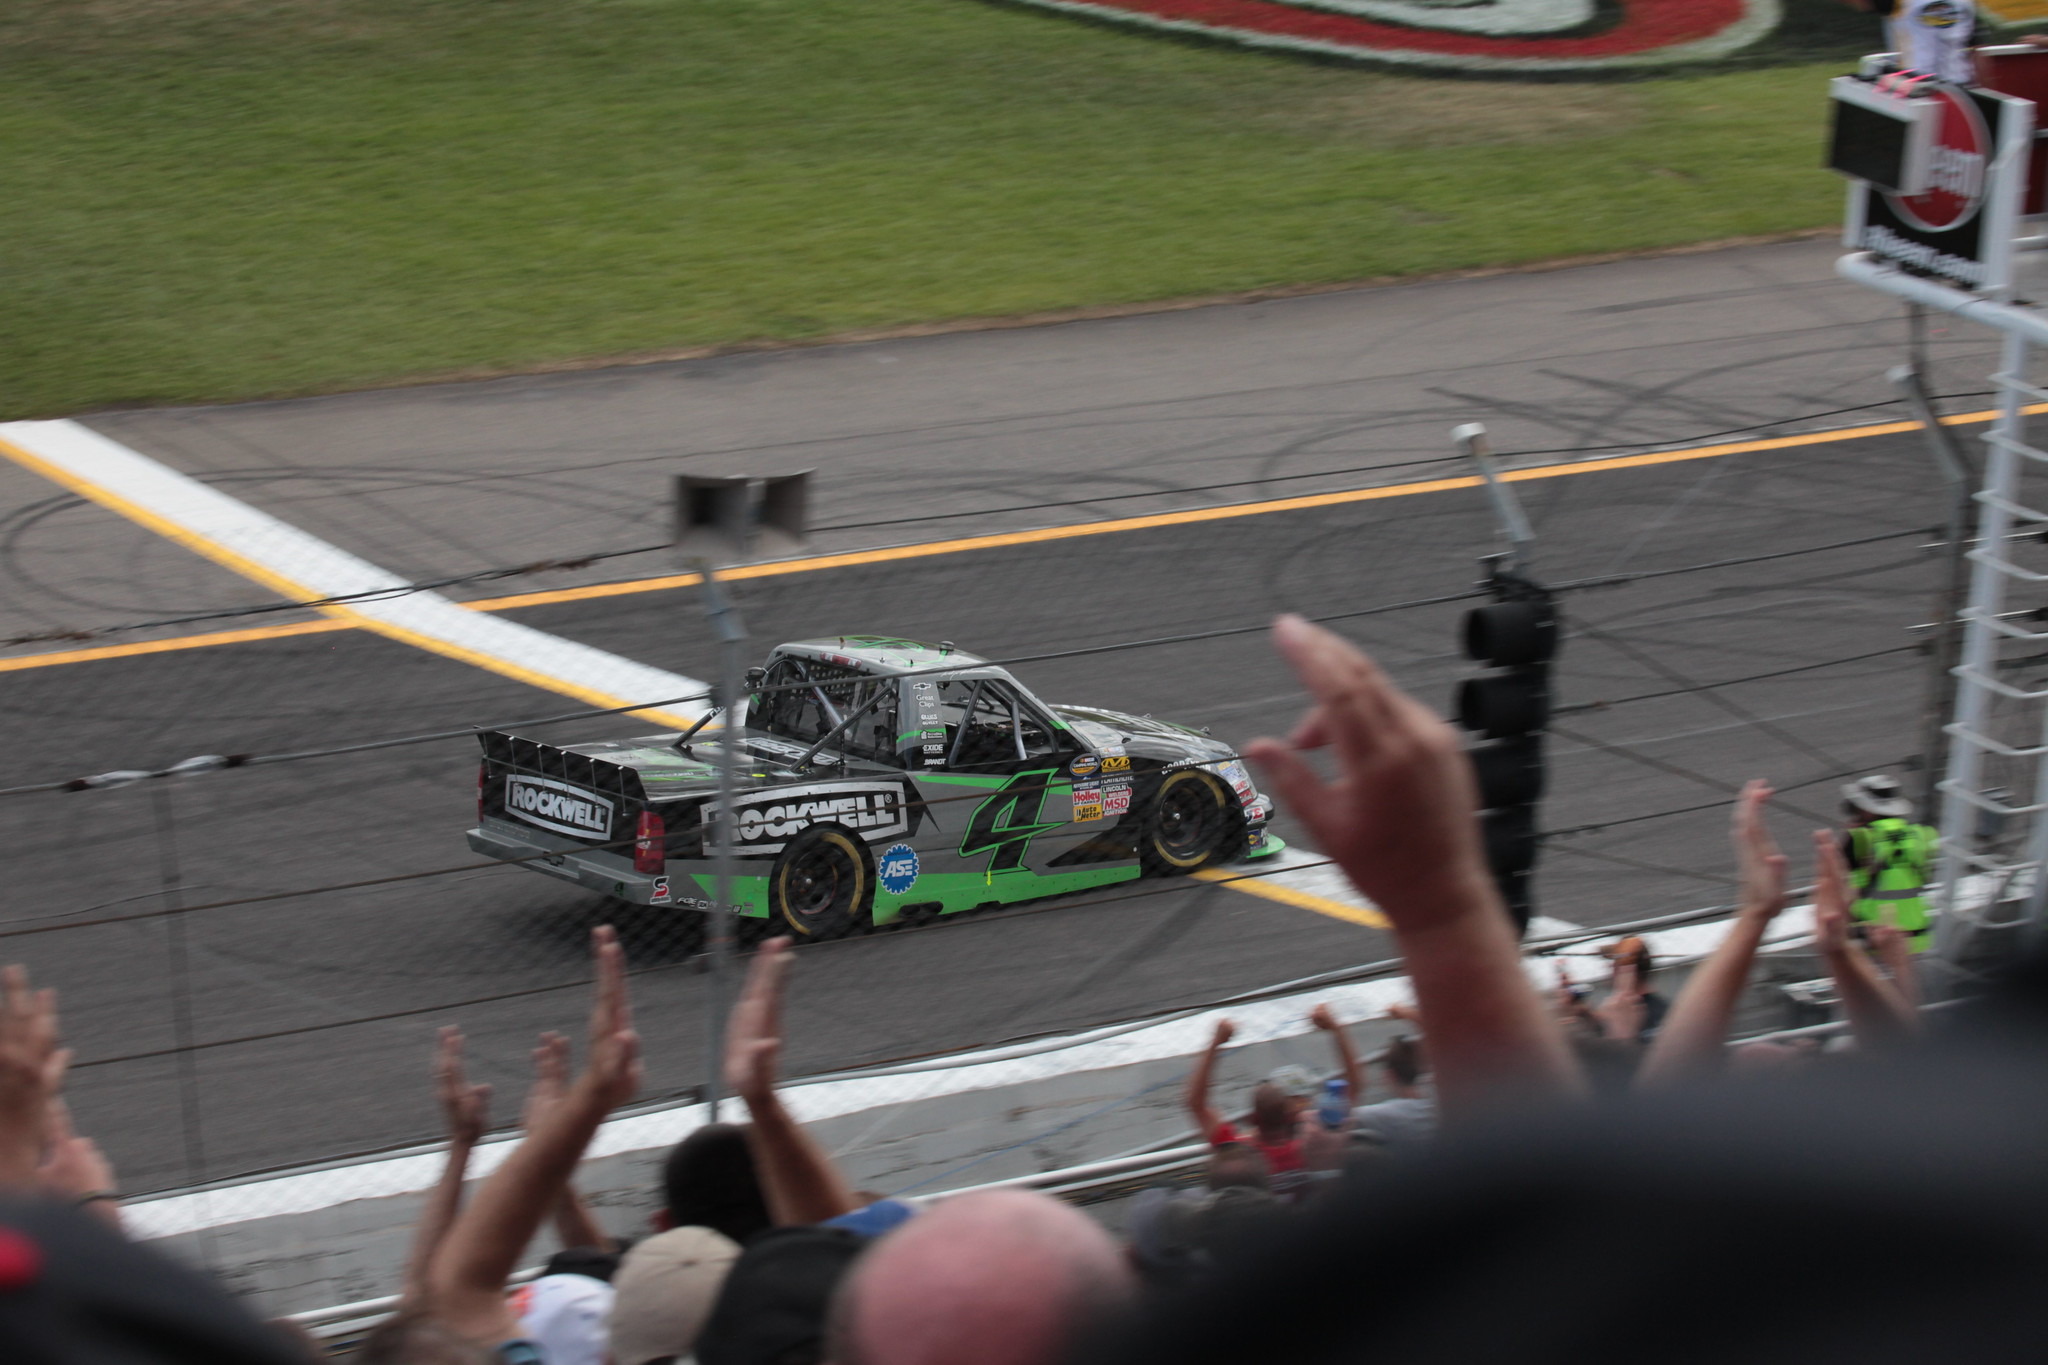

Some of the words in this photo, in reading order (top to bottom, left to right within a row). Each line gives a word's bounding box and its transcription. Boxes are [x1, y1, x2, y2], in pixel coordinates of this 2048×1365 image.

[918, 701, 935, 709] Clips
[922, 744, 944, 752] EXIDE
[1103, 785, 1127, 793] LINCOLN
[1073, 791, 1101, 803] Holley
[511, 783, 605, 831] ROCKWELL
[1105, 799, 1128, 810] MSD
[718, 794, 895, 842] OCKWELL
[958, 767, 1069, 876] 4
[1081, 812, 1101, 820] Meter
[884, 859, 914, 878] ASE
